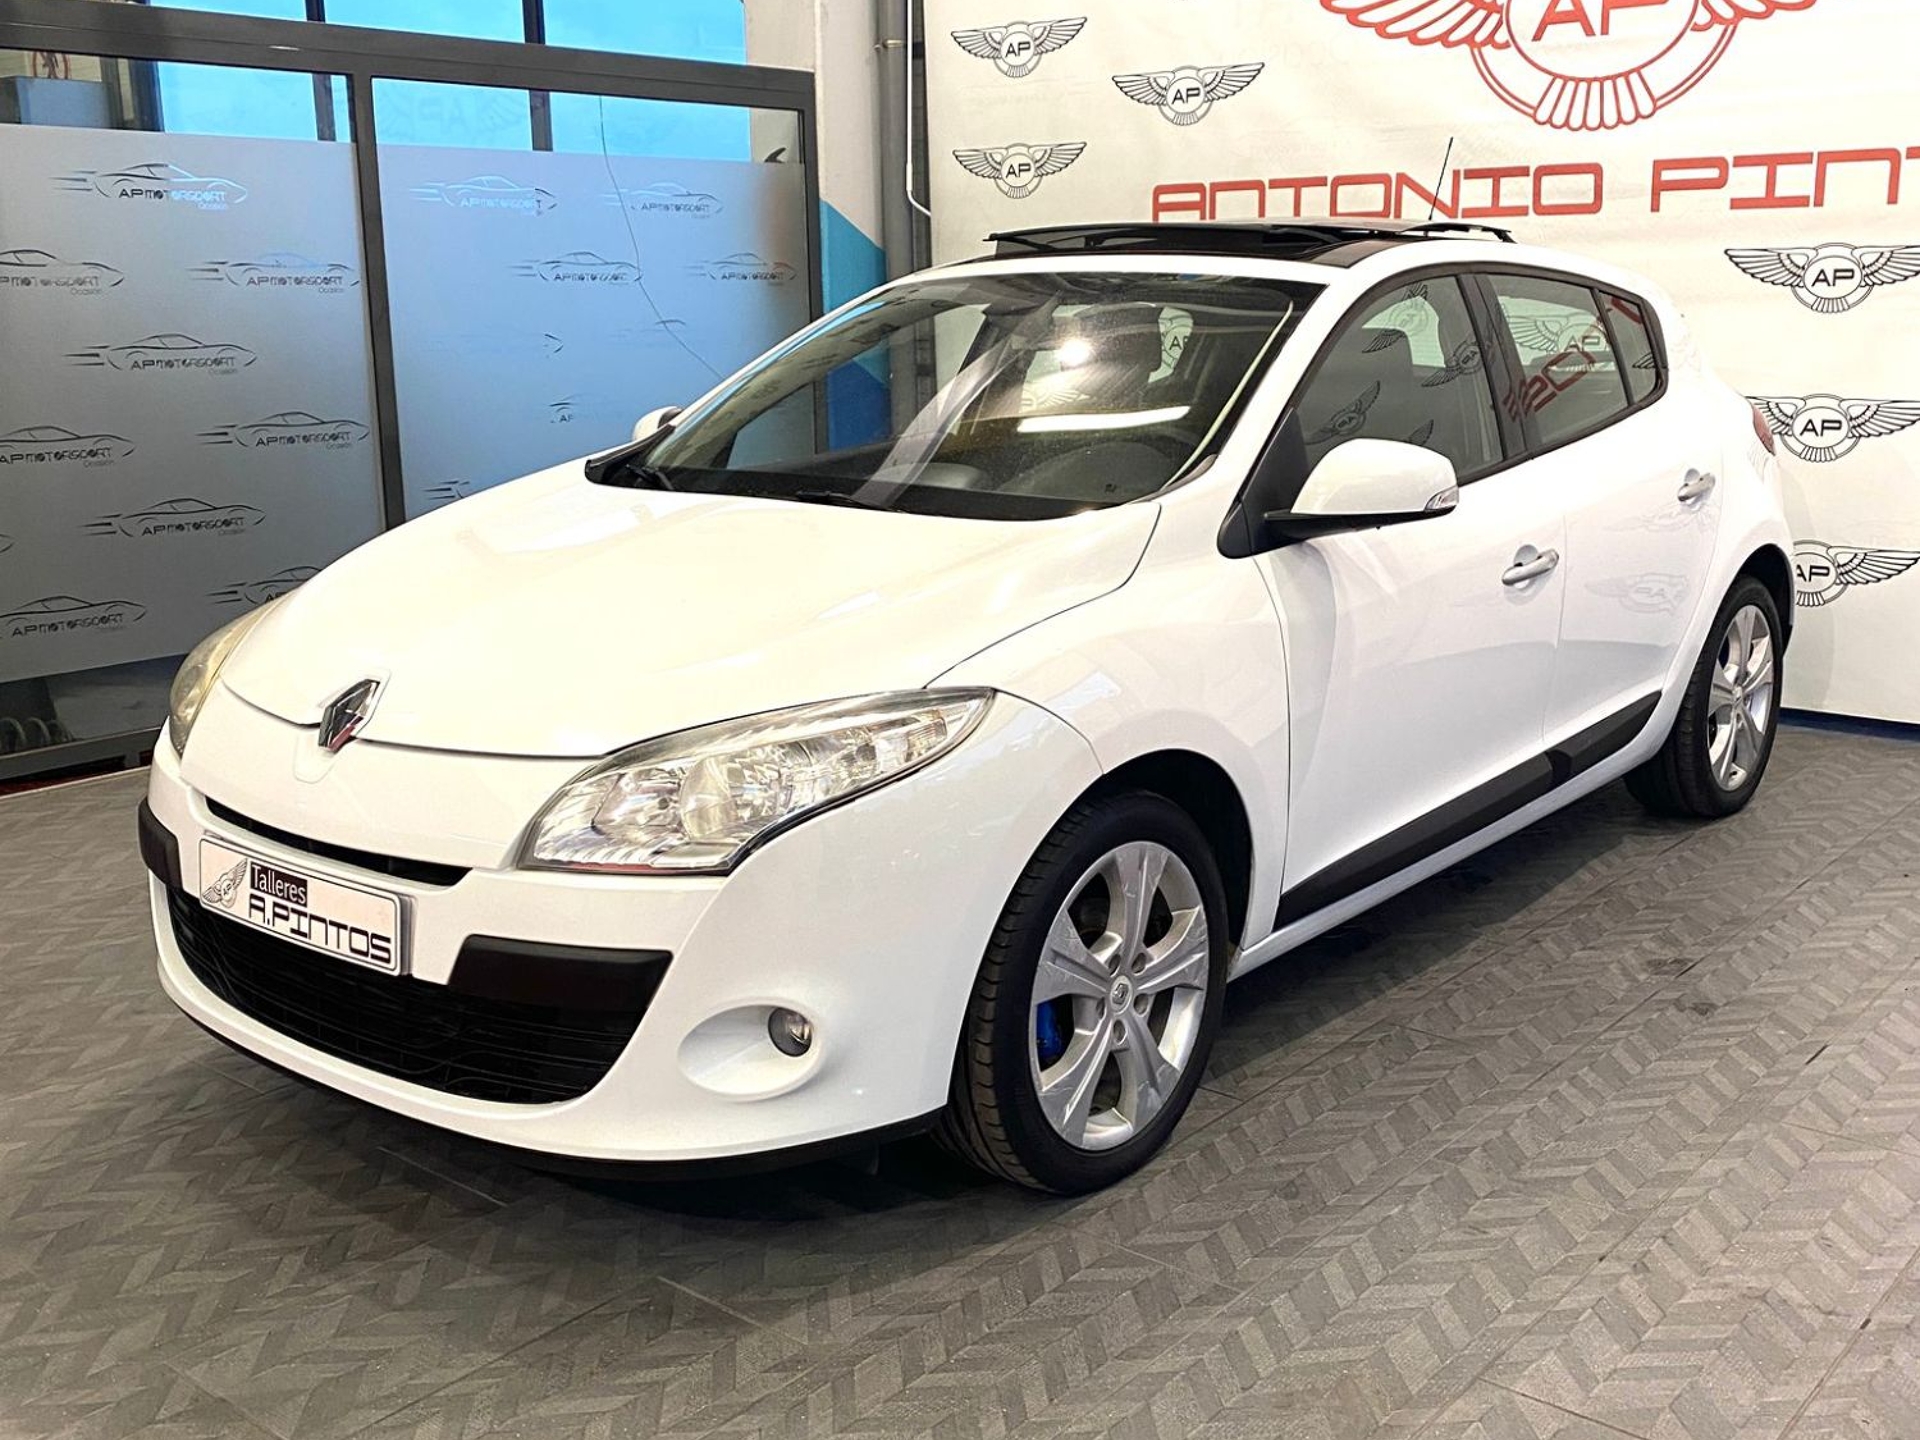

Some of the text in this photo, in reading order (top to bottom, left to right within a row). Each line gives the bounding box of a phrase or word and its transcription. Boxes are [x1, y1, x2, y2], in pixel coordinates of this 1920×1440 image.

[1004, 41, 1032, 58] AP
[1170, 86, 1201, 105] AP
[1005, 162, 1032, 178] AP
[1152, 146, 1920, 223] ANTONIO PIN
[1811, 268, 1855, 288] AP
[1799, 418, 1843, 437] AP
[252, 865, 307, 905] Talleres
[249, 893, 392, 965] A.PINTOS
